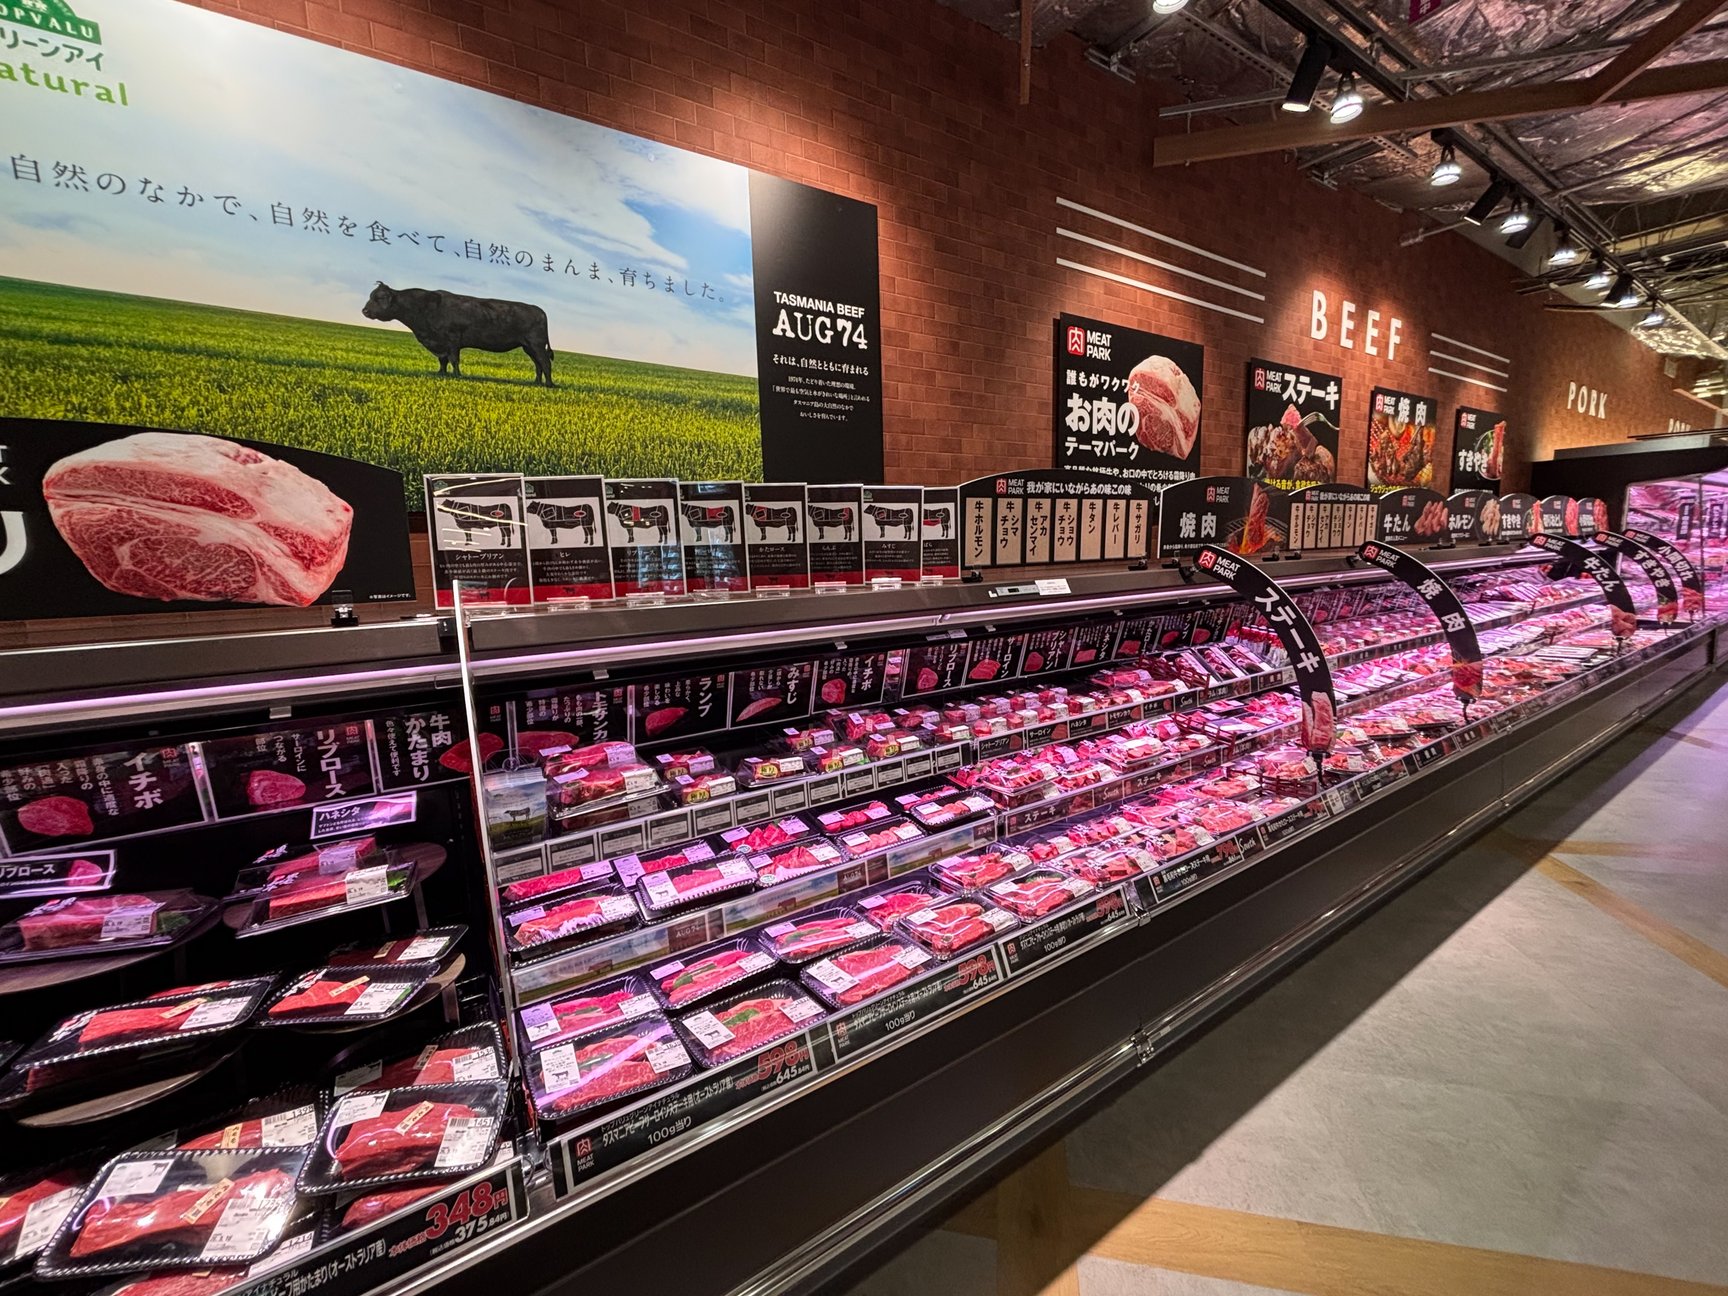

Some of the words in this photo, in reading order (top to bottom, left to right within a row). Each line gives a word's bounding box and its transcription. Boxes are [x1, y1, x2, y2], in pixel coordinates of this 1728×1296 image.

[0, 62, 128, 106] atural
[773, 291, 834, 314] TASMANIA
[836, 303, 866, 319] BEEF
[1086, 330, 1112, 347] MEAT
[1310, 290, 1402, 361] BEEF
[1086, 346, 1111, 361] PARK
[1066, 369, 1141, 394] 誰もがワクワク
[1266, 370, 1282, 382] MEAT
[1266, 381, 1282, 393] PARK
[1282, 373, 1339, 410] ステーキ
[1384, 396, 1396, 406] MEAT
[1567, 381, 1608, 419] PORK
[1065, 393, 1140, 437] お肉の
[1398, 396, 1427, 426] 焼肉
[1065, 437, 1140, 461] テーマパーク
[1459, 449, 1488, 472] すきやき
[1008, 479, 1025, 487] MEAT
[1008, 487, 1024, 495] PARK
[1026, 481, 1132, 496] 我が家にいながらあの味この味
[1216, 486, 1230, 494] MEAT
[1006, 501, 1015, 512] 牛
[1035, 501, 1043, 512] 牛
[1063, 501, 1071, 512] 牛
[1216, 495, 1230, 503] PARK
[974, 500, 984, 558] 牛ホルモン
[1011, 515, 1020, 537] シマ
[1040, 515, 1048, 536] アカ
[1057, 515, 1066, 546] チョウ
[1067, 515, 1075, 546] ショウ
[1088, 502, 1097, 533] 牛タン
[1112, 502, 1120, 544] 牛レバー
[1134, 502, 1142, 544] 牛サガリ
[1180, 512, 1217, 538] 焼肉
[1384, 514, 1411, 533] 牛たん
[1448, 514, 1475, 530] ホルモン
[1000, 515, 1009, 549] チョウ
[1029, 515, 1038, 556] センマイ
[455, 553, 505, 561] シャトーブリアン
[1216, 557, 1241, 572] MEAT
[1376, 556, 1397, 569] PARK
[1379, 549, 1400, 562] MEAT
[1633, 550, 1671, 588] すきやき
[1213, 563, 1237, 581] PARK
[1584, 556, 1620, 593] 牛たん
[1417, 578, 1466, 633] 焼肉
[1182, 614, 1192, 639] ランプ
[1254, 586, 1321, 674] ステーキ
[1045, 630, 1060, 670] ブリアン
[1054, 630, 1067, 668] シャトー
[1099, 625, 1113, 660] ハネシタ
[943, 644, 958, 688] リブロース
[1001, 636, 1016, 678] サーロイン
[787, 667, 800, 705] みすじ
[861, 656, 875, 691] イチボ
[698, 677, 712, 717] ランプ
[429, 714, 453, 748] 牛肉
[592, 691, 609, 743] トモサンカ
[1070, 719, 1087, 728] ハネシタ
[1029, 727, 1051, 739] サーロイン
[291, 733, 307, 772] サーロインに
[317, 729, 347, 798] リブロース
[404, 718, 430, 782] かたまり
[123, 752, 164, 809] イチボ
[1137, 773, 1162, 788] ステーキ
[319, 806, 361, 821] ハネシタ
[1024, 806, 1056, 823] ステーキ
[885, 1010, 915, 1031] 100g当り
[757, 1040, 810, 1081] 598円
[648, 1115, 692, 1145] 100g当り
[576, 1154, 593, 1166] MEAT
[578, 1160, 594, 1172] PARK
[425, 1181, 509, 1240] 348円
